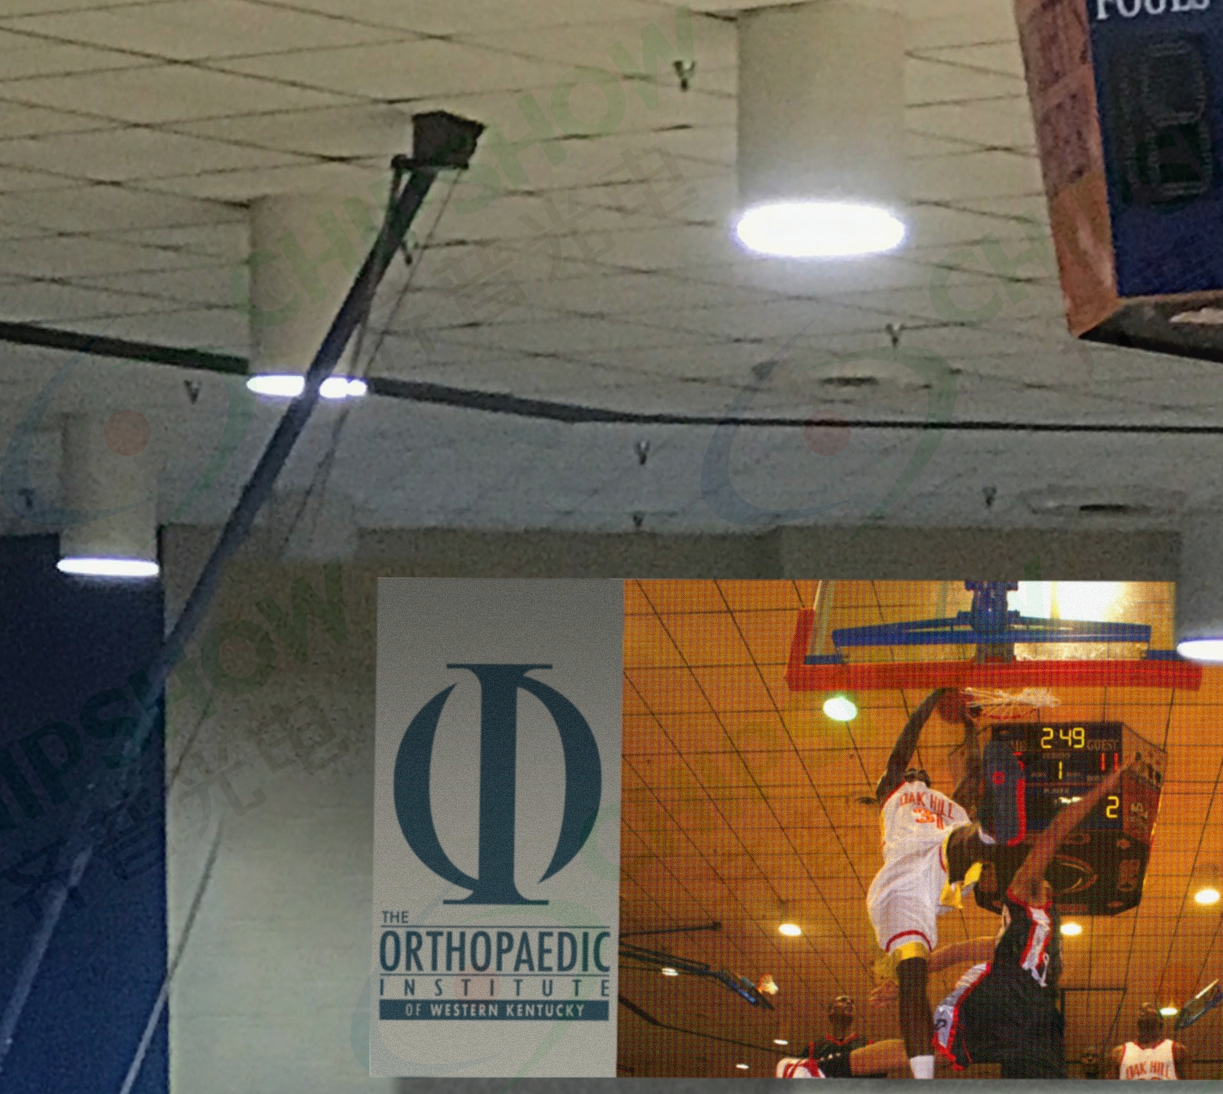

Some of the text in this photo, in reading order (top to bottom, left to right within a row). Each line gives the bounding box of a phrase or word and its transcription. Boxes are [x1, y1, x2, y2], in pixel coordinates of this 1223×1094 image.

[382, 911, 409, 923] THE
[380, 930, 611, 972] ORTHOPAEDIC
[380, 978, 610, 996] INSTITUTE
[405, 1004, 585, 1016] OF WESTERN KENTUCKY
